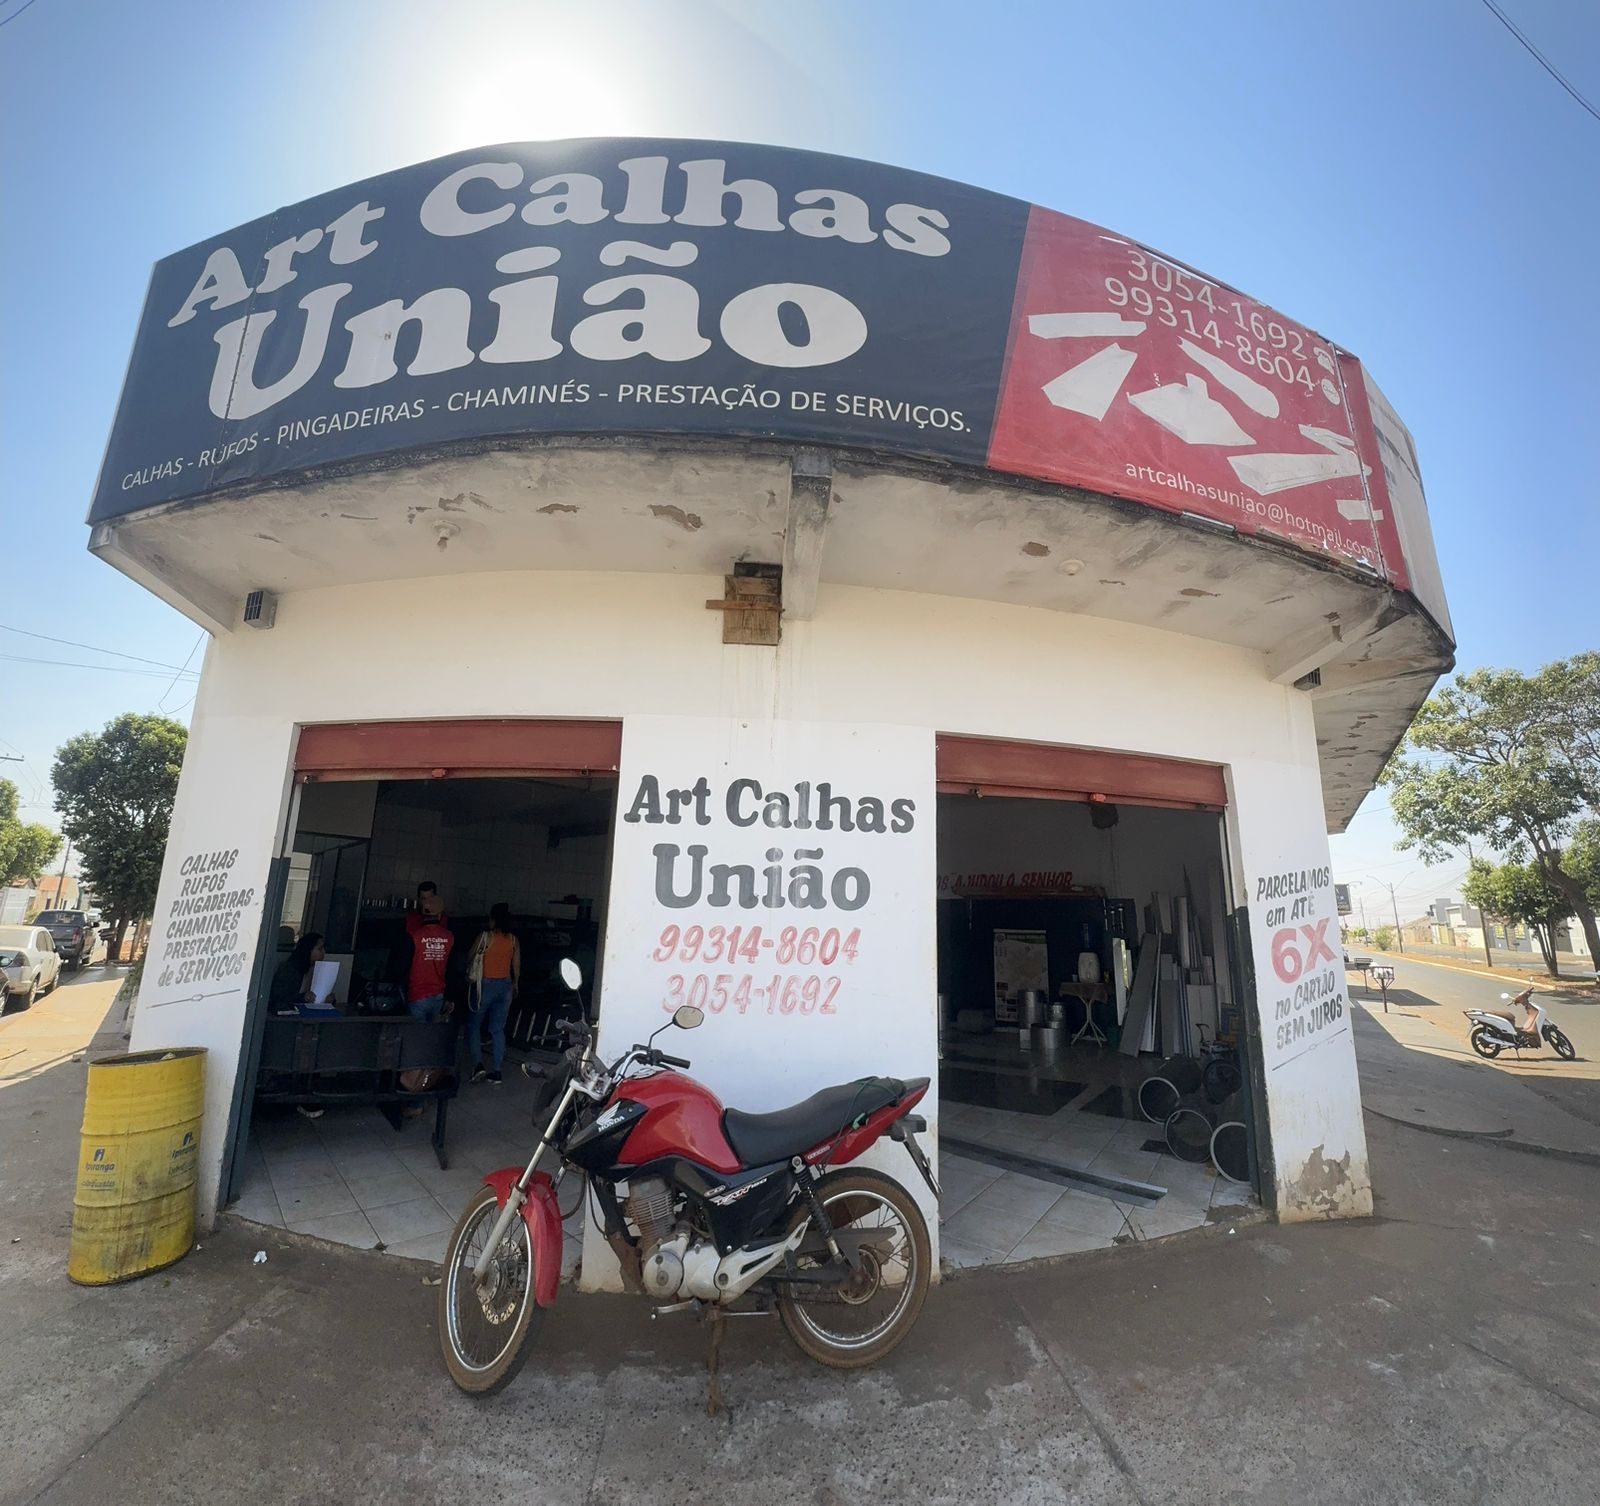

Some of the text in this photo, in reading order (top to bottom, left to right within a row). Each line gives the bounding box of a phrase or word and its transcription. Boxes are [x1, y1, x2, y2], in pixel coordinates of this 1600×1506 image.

[168, 156, 951, 328] Art Calhas
[1128, 250, 1308, 361] 3054-1692
[209, 241, 868, 420] União
[1105, 277, 1320, 393] 99314-8604
[121, 458, 183, 491] CALHAS
[199, 432, 259, 468] RUFOS
[277, 400, 424, 445] PINGADEIRAS
[447, 378, 591, 412] CHAMINÉS
[618, 383, 782, 410] PRESTAÇÃO
[791, 392, 828, 412] DE
[835, 394, 972, 433] SERVIÇOS.
[1125, 463, 1375, 560] artcalhasuniao@hotmail.com
[624, 775, 916, 834] Art Calhas
[180, 849, 239, 876] CALHAS
[652, 843, 871, 911] União
[1019, 871, 1073, 889] SENHOR
[170, 888, 255, 918] PINGADEIRAS
[180, 872, 228, 897] RUFOS
[1256, 866, 1330, 903] PARCELAMOS
[166, 909, 241, 939] CHAMINÉS
[1266, 904, 1286, 928] em
[162, 930, 239, 961] PRESTAÇÃO
[652, 924, 862, 966] 99314-8604
[1271, 917, 1338, 984] 6X
[157, 951, 247, 987] de SERVIÇOS
[662, 974, 842, 1015] 3054-1692
[1275, 968, 1335, 1021] no CARTÃO
[1276, 992, 1343, 1050] SEM JUROS
[598, 1116, 625, 1133] HONDA
